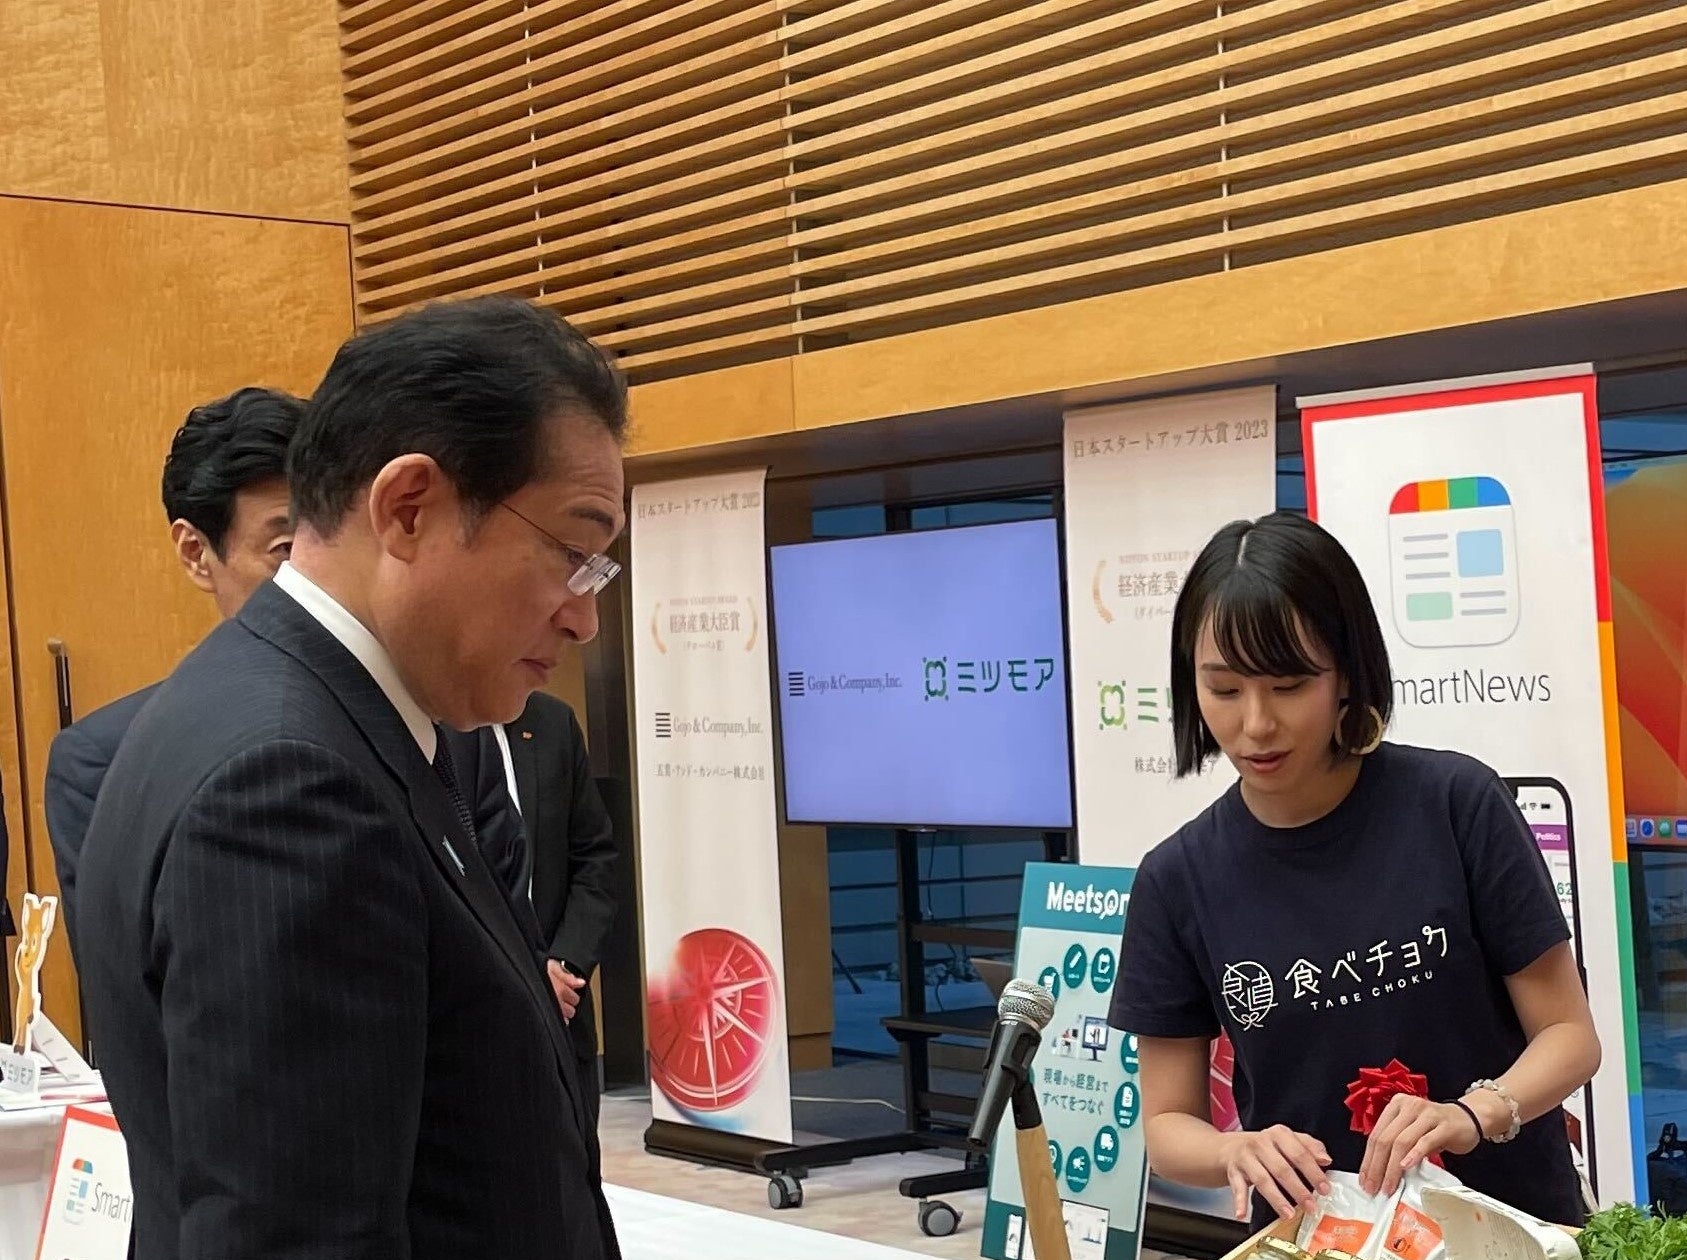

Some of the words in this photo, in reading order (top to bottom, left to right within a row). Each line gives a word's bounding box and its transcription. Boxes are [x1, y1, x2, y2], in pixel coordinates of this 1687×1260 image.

[1234, 419, 1269, 441] 2023
[1118, 567, 1188, 598] 経済産業
[957, 657, 1054, 693] ミツモア
[1285, 925, 1448, 999] 食べチョク
[1310, 992, 1362, 1011] TABE
[1372, 970, 1434, 997] CHOKU
